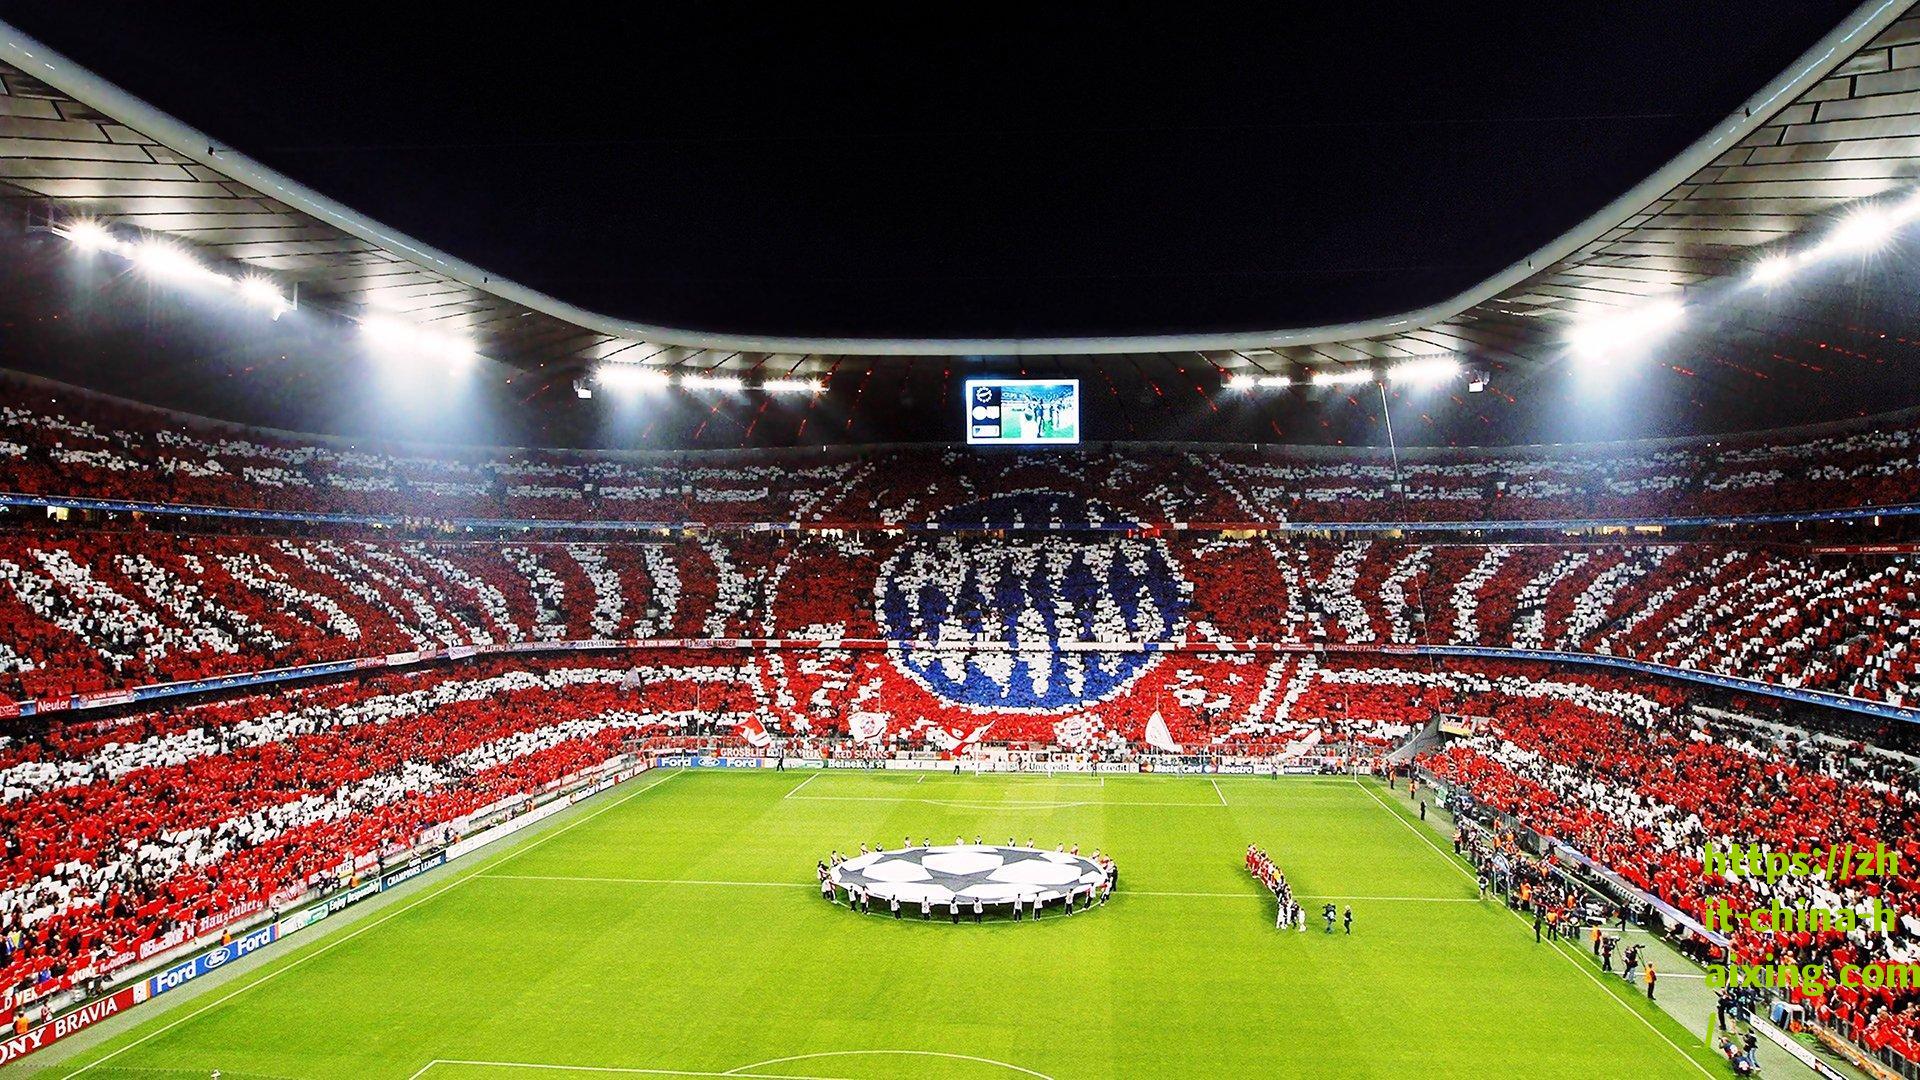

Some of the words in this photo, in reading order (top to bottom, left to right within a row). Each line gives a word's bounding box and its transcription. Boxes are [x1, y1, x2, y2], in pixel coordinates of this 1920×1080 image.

[37, 699, 70, 713] Neuler
[661, 757, 692, 768] Ford
[726, 757, 757, 768] Ford
[386, 864, 421, 887] CHAMPIONS
[420, 855, 442, 872] LEAGUE
[329, 896, 347, 911] Enjoy
[237, 928, 271, 956] Ford
[157, 960, 197, 992] Ford
[54, 996, 118, 1039] BRAVIA
